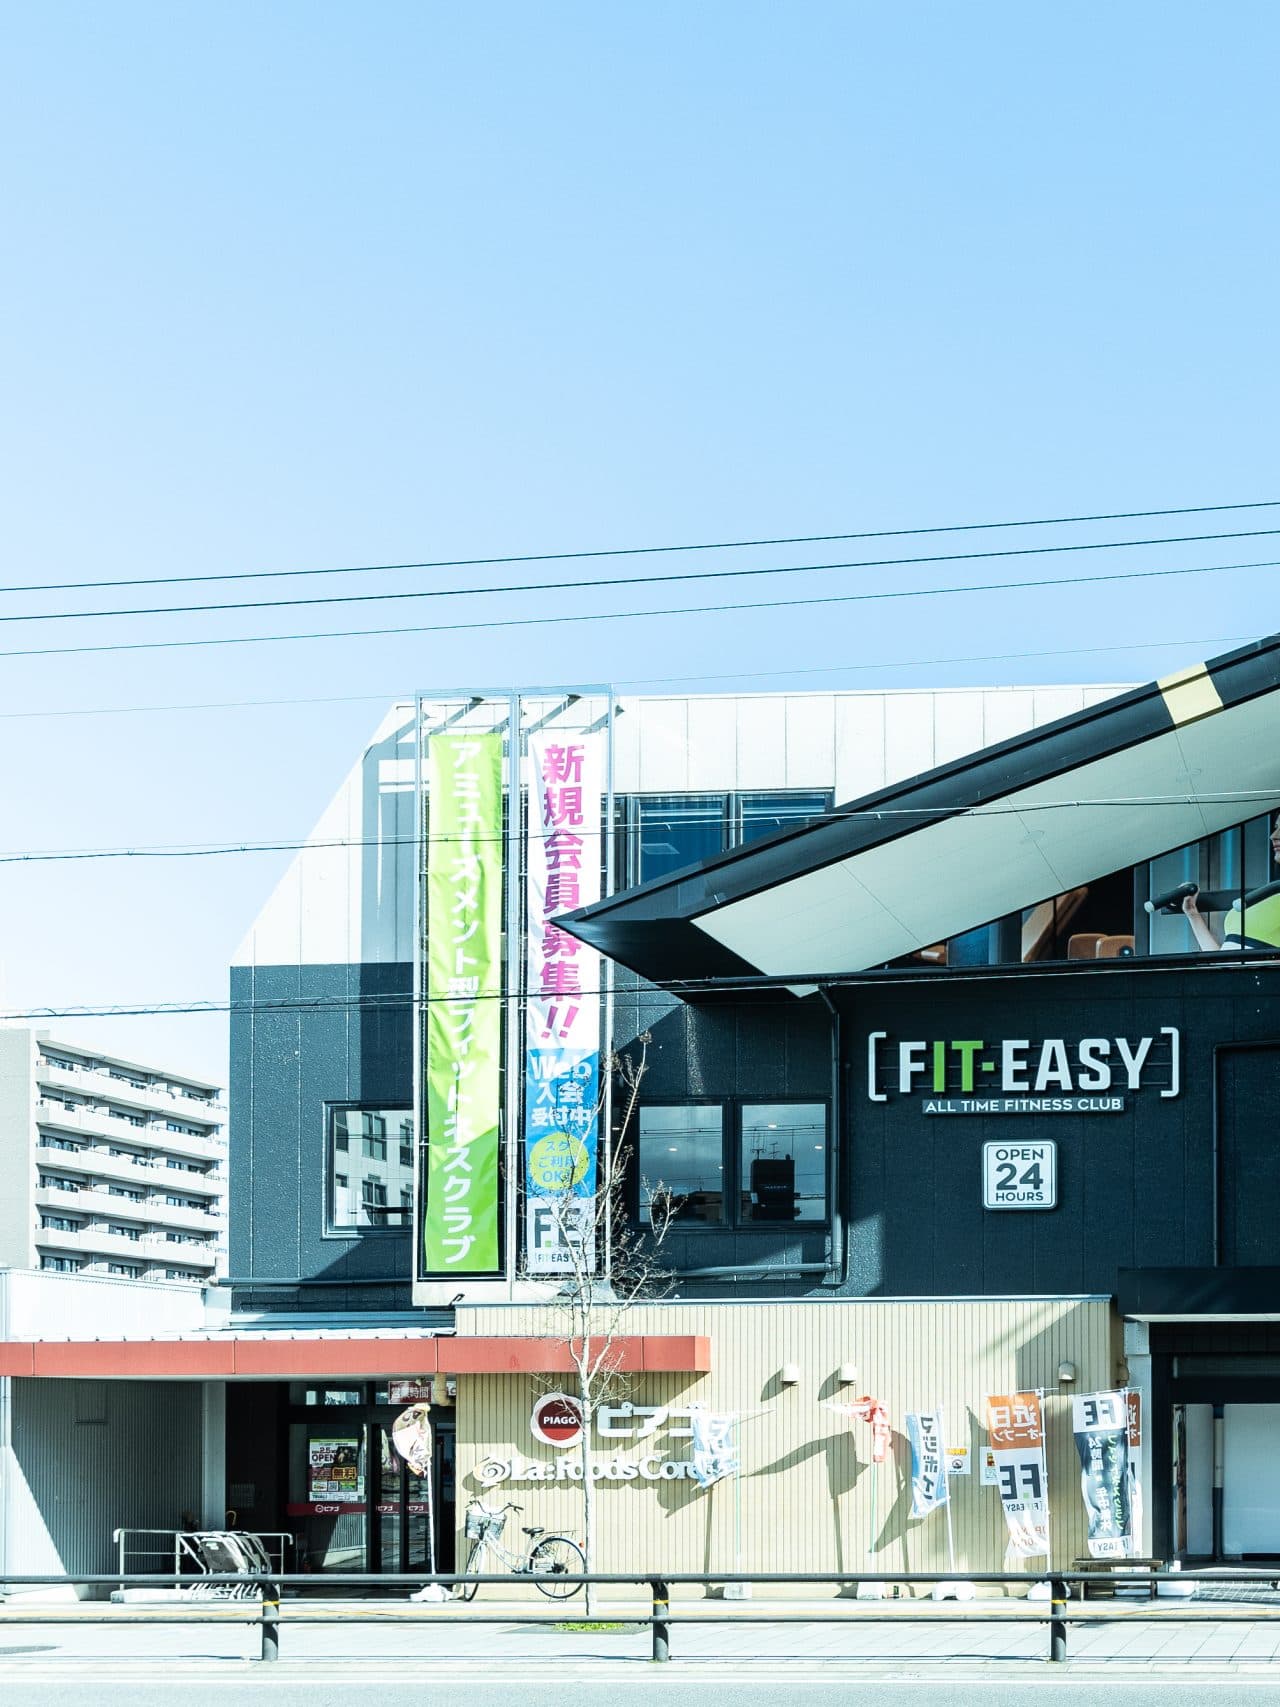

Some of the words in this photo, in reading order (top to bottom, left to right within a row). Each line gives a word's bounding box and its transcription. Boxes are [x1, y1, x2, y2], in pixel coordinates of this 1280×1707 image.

[531, 1056, 592, 1080] Web
[536, 1080, 584, 1104] 入会
[925, 1101, 956, 1113] ALL
[961, 1101, 999, 1112] TIME
[1004, 1100, 1073, 1112] FITNESS
[1078, 1099, 1121, 1110] CLUB
[531, 1106, 591, 1127] 受付中
[996, 1149, 1044, 1161] OPEN
[996, 1163, 1044, 1190] 24
[995, 1191, 1044, 1202] HOURS
[543, 1416, 577, 1425] PIAGO
[312, 1454, 335, 1462] OPEN
